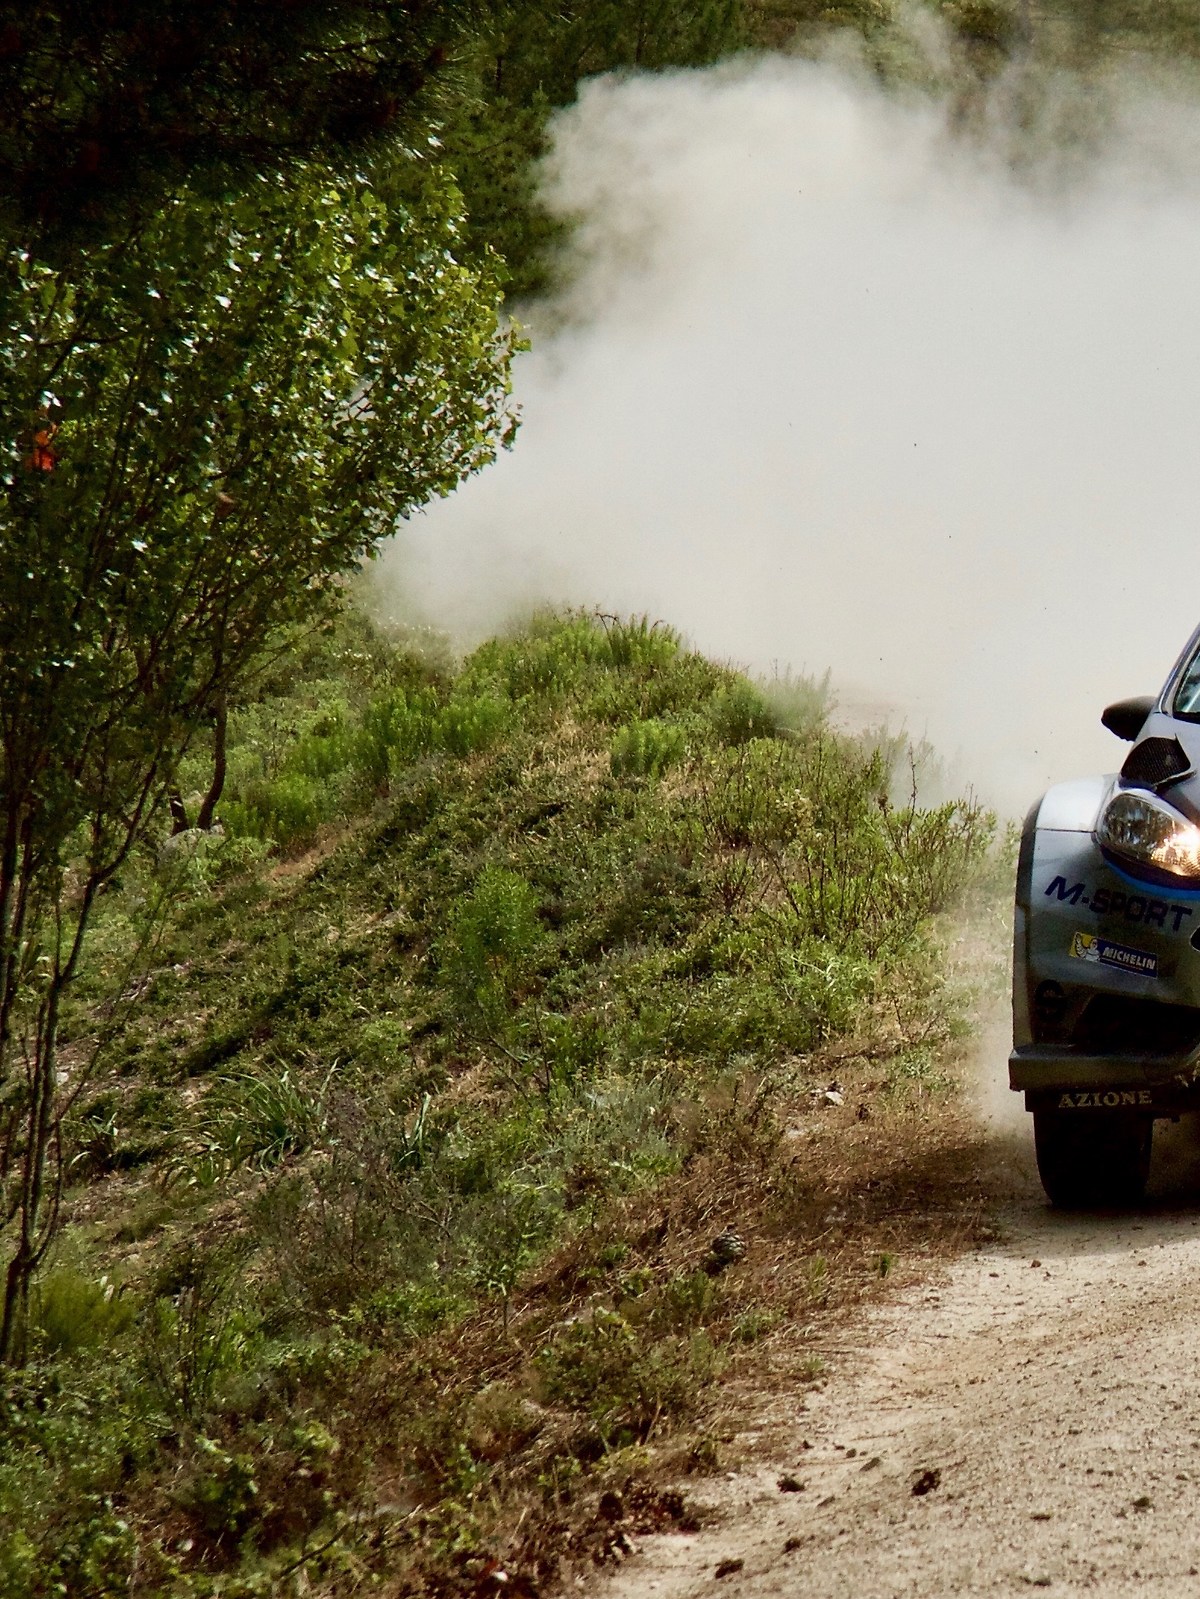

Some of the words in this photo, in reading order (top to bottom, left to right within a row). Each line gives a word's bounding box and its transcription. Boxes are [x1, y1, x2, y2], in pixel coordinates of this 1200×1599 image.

[1044, 875, 1193, 933] M-SPORT
[1102, 946, 1156, 971] MICHELIN
[1058, 1090, 1153, 1108] AZIONE
